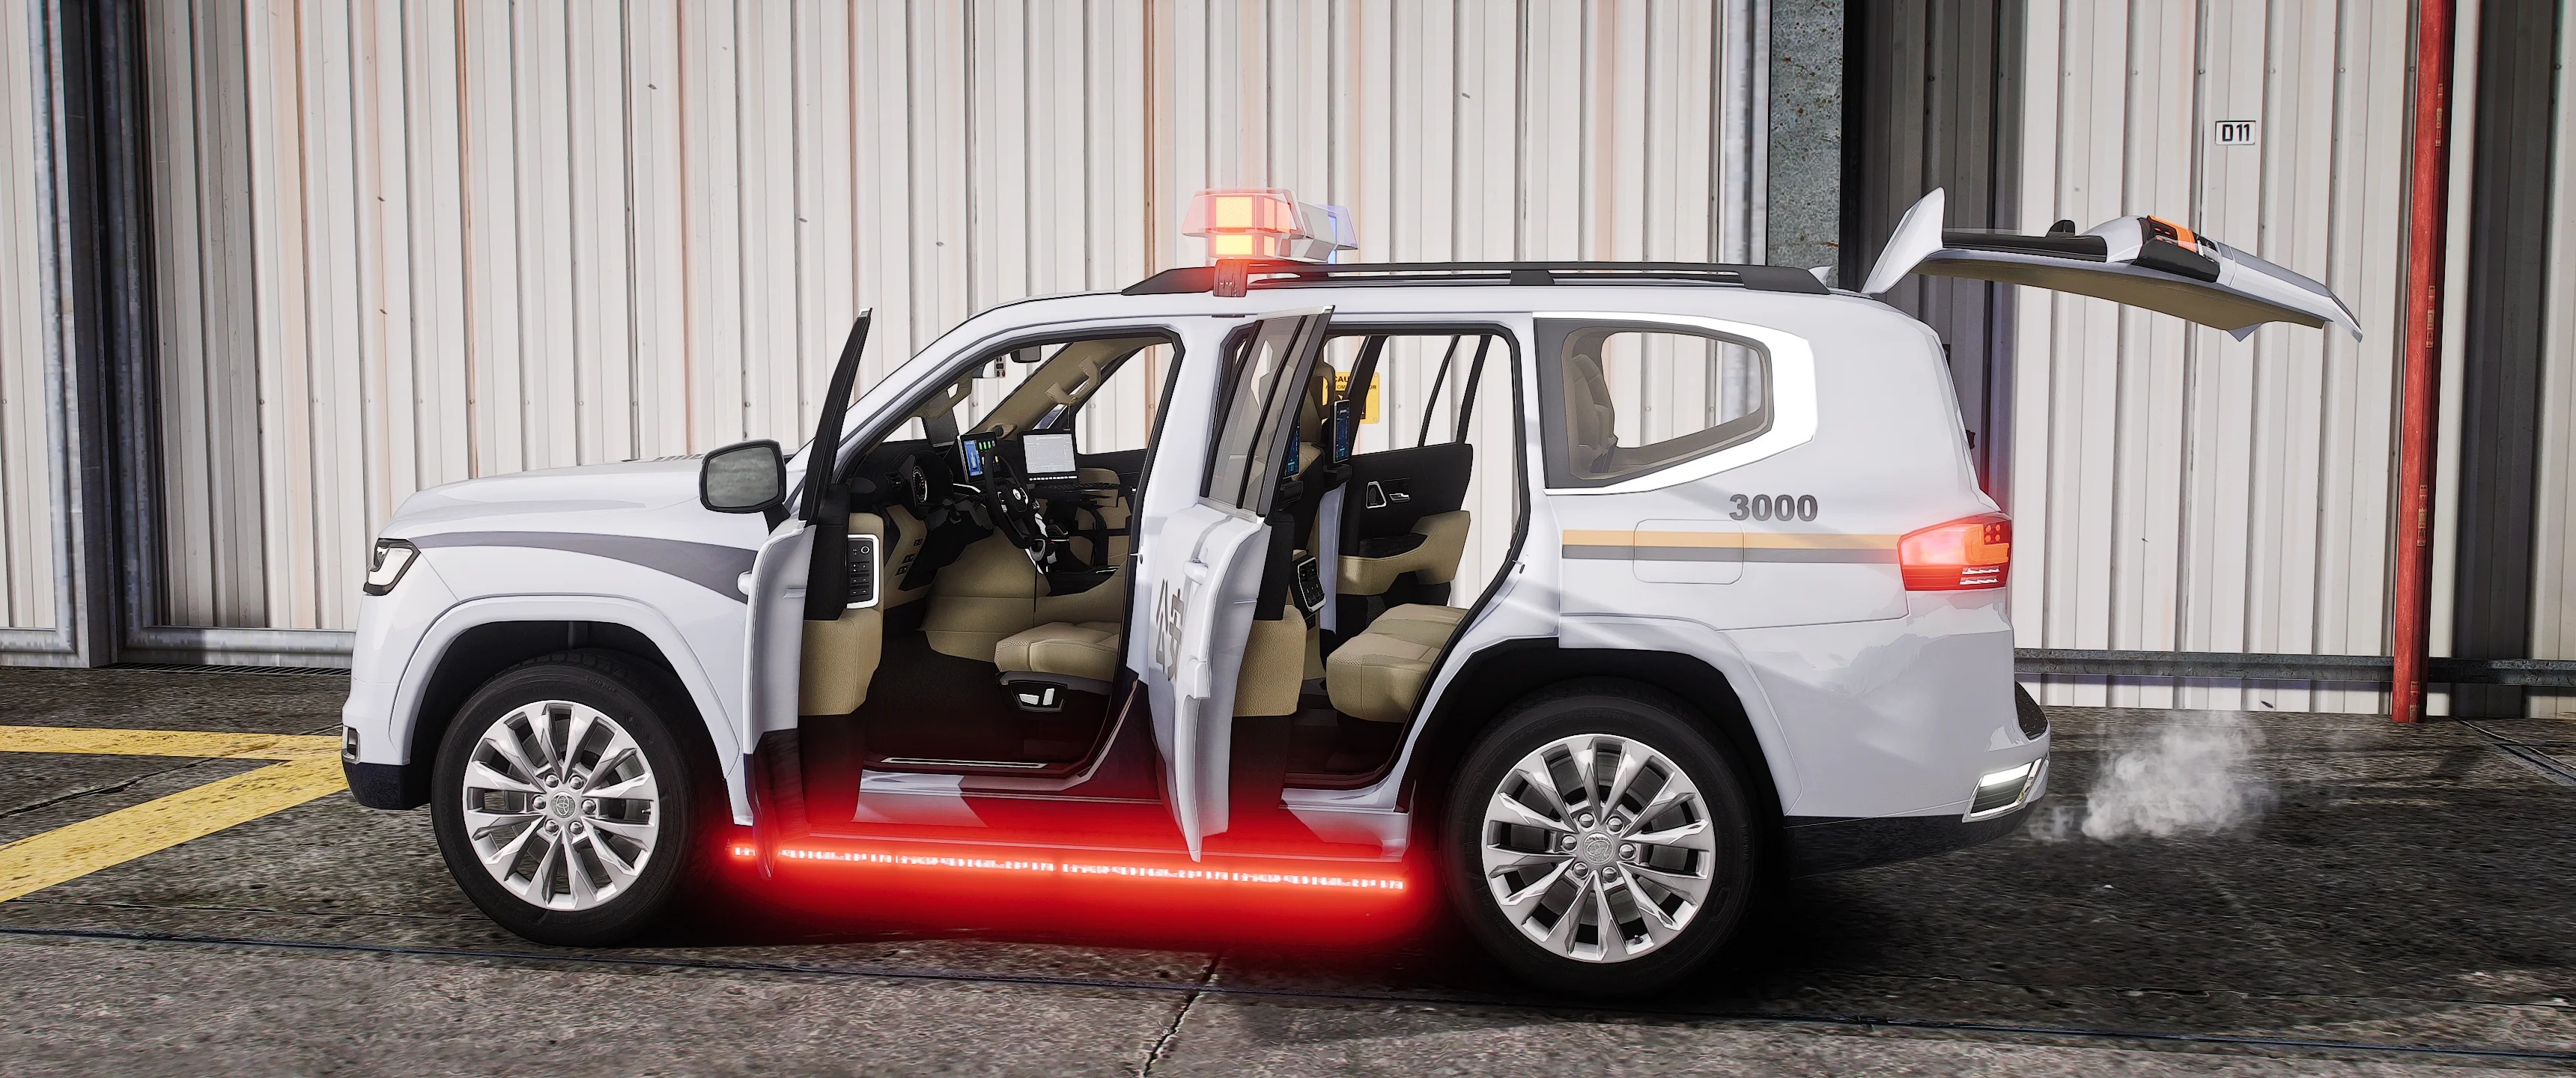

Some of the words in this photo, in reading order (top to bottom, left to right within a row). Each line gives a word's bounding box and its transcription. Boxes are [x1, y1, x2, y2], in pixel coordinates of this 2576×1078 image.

[2223, 124, 2250, 141] D11
[1729, 493, 1818, 522] 3000
[1155, 578, 1185, 682] 公安
